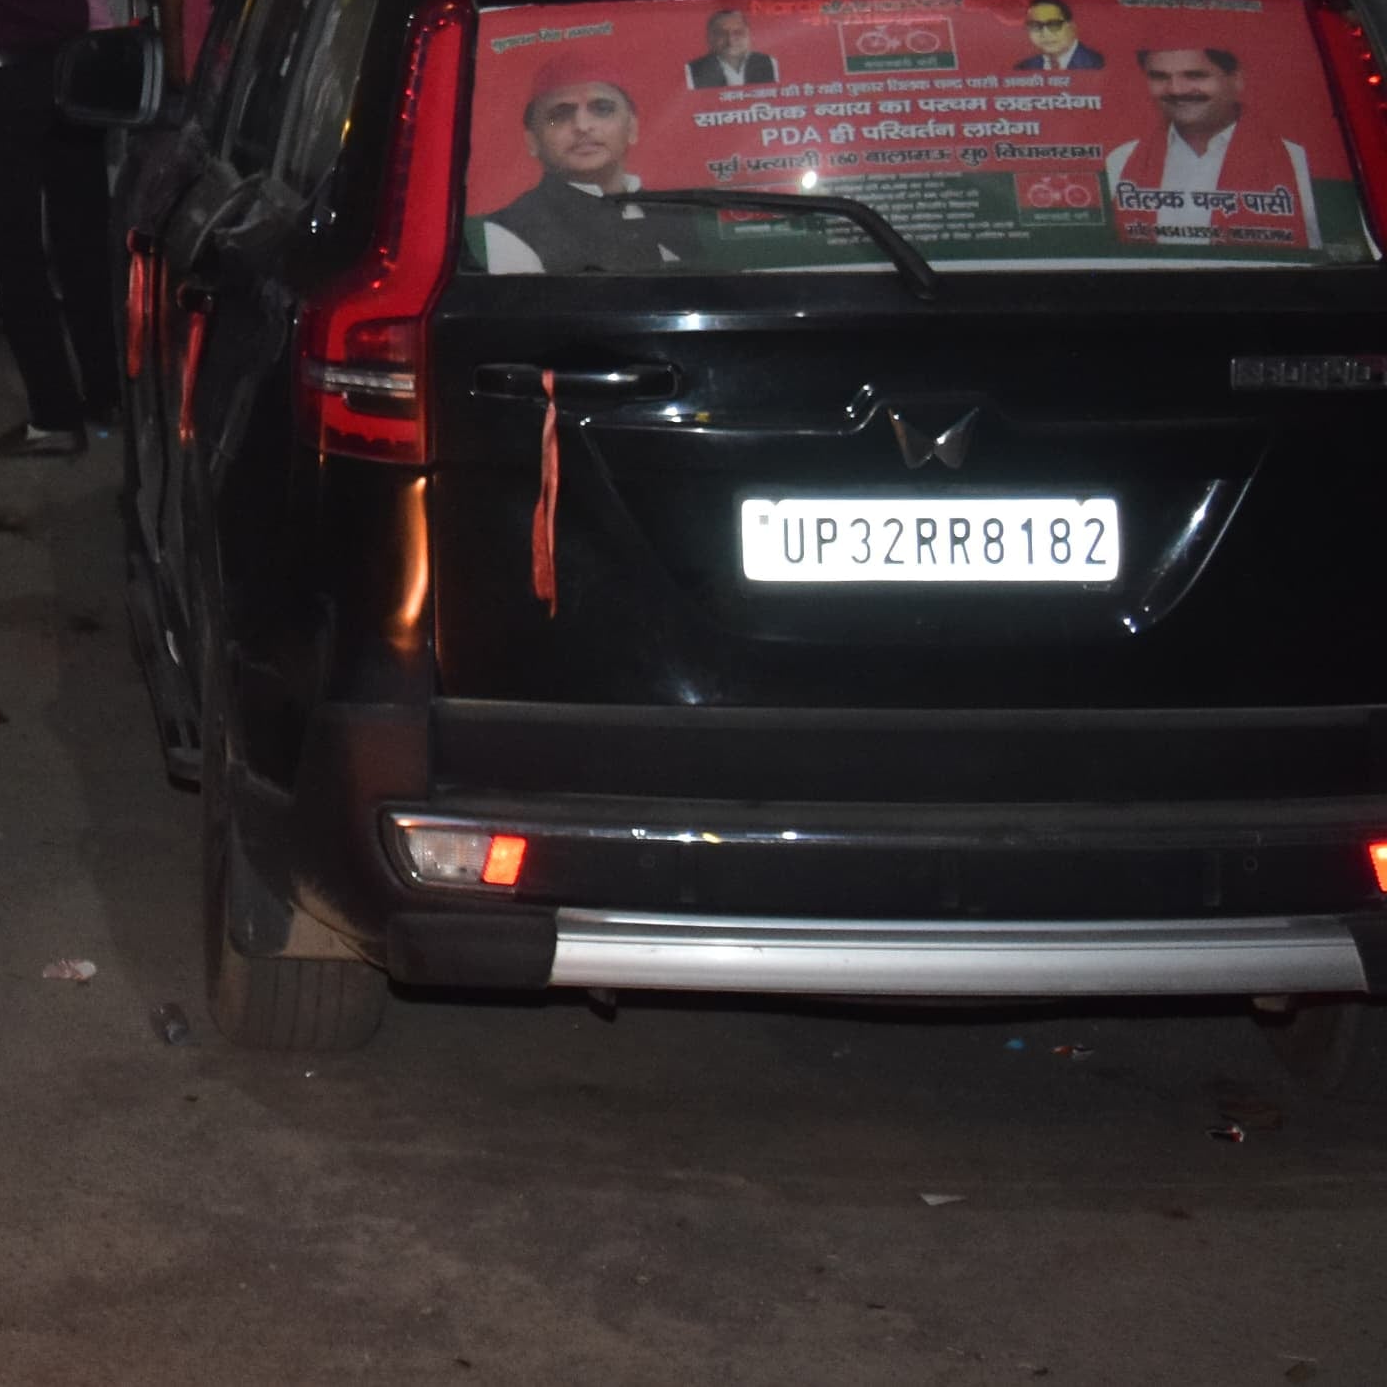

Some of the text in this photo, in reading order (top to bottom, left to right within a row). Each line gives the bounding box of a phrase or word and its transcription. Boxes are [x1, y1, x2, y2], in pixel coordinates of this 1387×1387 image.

[694, 104, 806, 126] सामाजिक
[814, 101, 872, 117] न्याय
[878, 98, 912, 114] का
[918, 96, 987, 112] परचम
[762, 118, 1041, 146] PDA ही परिवर्तन लायेगा
[708, 155, 740, 180] पूर्व
[746, 150, 820, 172] प्रत्याशी
[995, 141, 1103, 161] विधानसभा
[1115, 182, 1295, 216] तिलक चन्द्र पासी
[783, 516, 1107, 565] UP32RR8182
